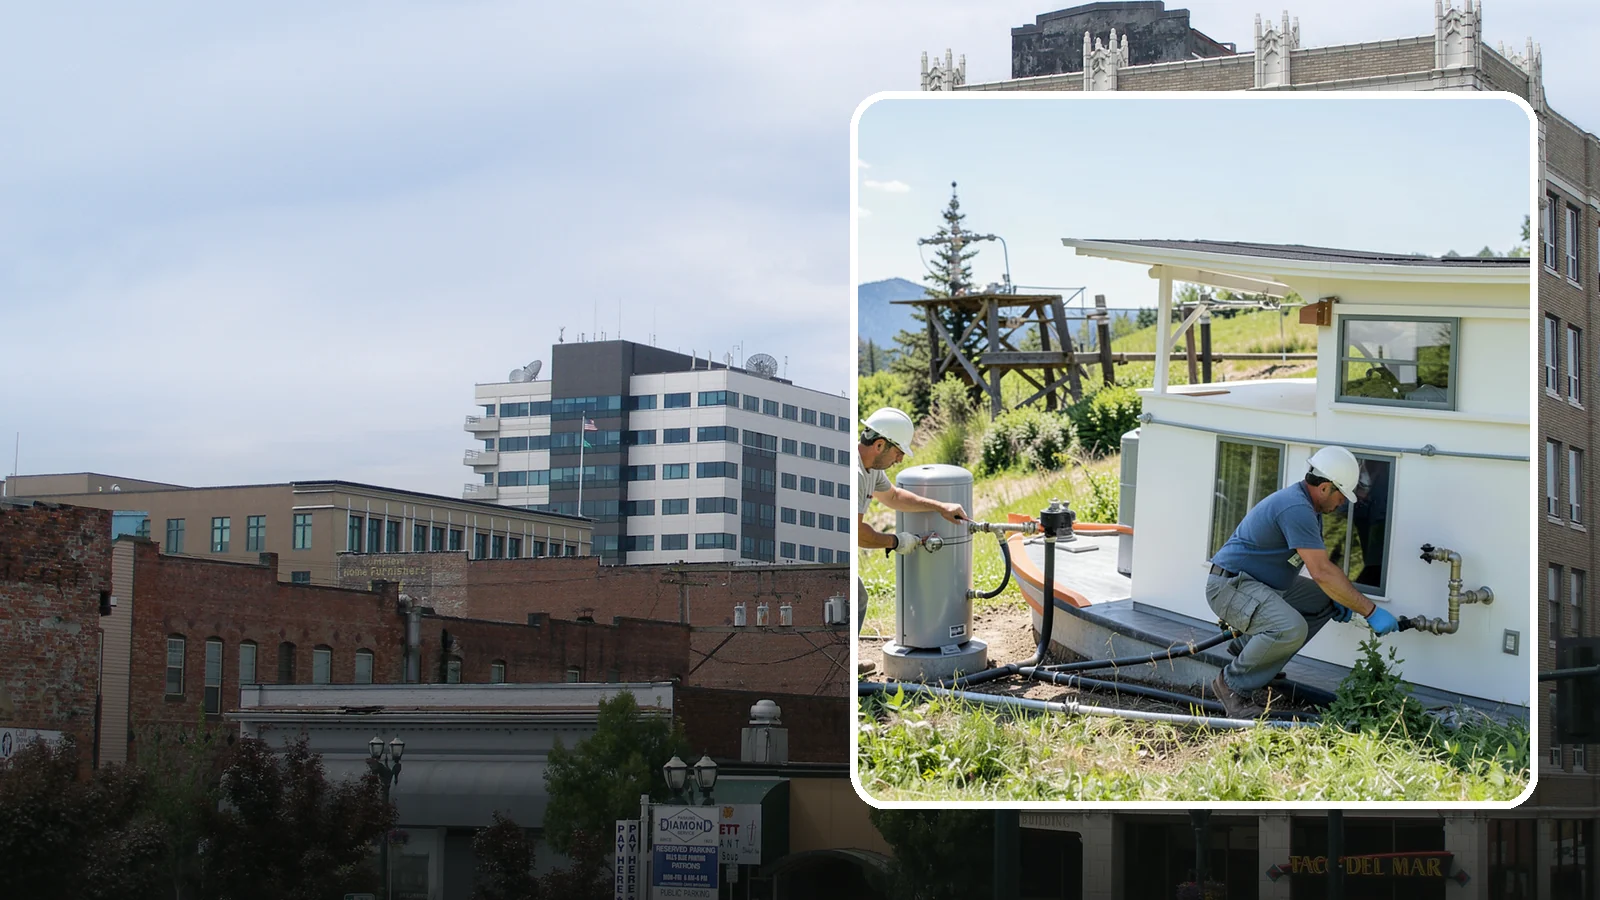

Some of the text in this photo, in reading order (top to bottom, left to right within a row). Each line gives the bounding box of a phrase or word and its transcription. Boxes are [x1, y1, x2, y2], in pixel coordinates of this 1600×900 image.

[370, 566, 427, 577] Furnishers
[660, 818, 713, 832] DIAMOND
[1021, 815, 1071, 828] BUILDING
[655, 845, 716, 854] RESERVED PARKING
[616, 824, 625, 894] PAY HERE
[627, 824, 637, 893] PAY HERE
[721, 851, 739, 862] Soup
[671, 862, 701, 870] PATRONS
[1346, 856, 1385, 876] DEL
[1392, 856, 1443, 877] MAR
[660, 888, 710, 898] PUBLIC PARKING
